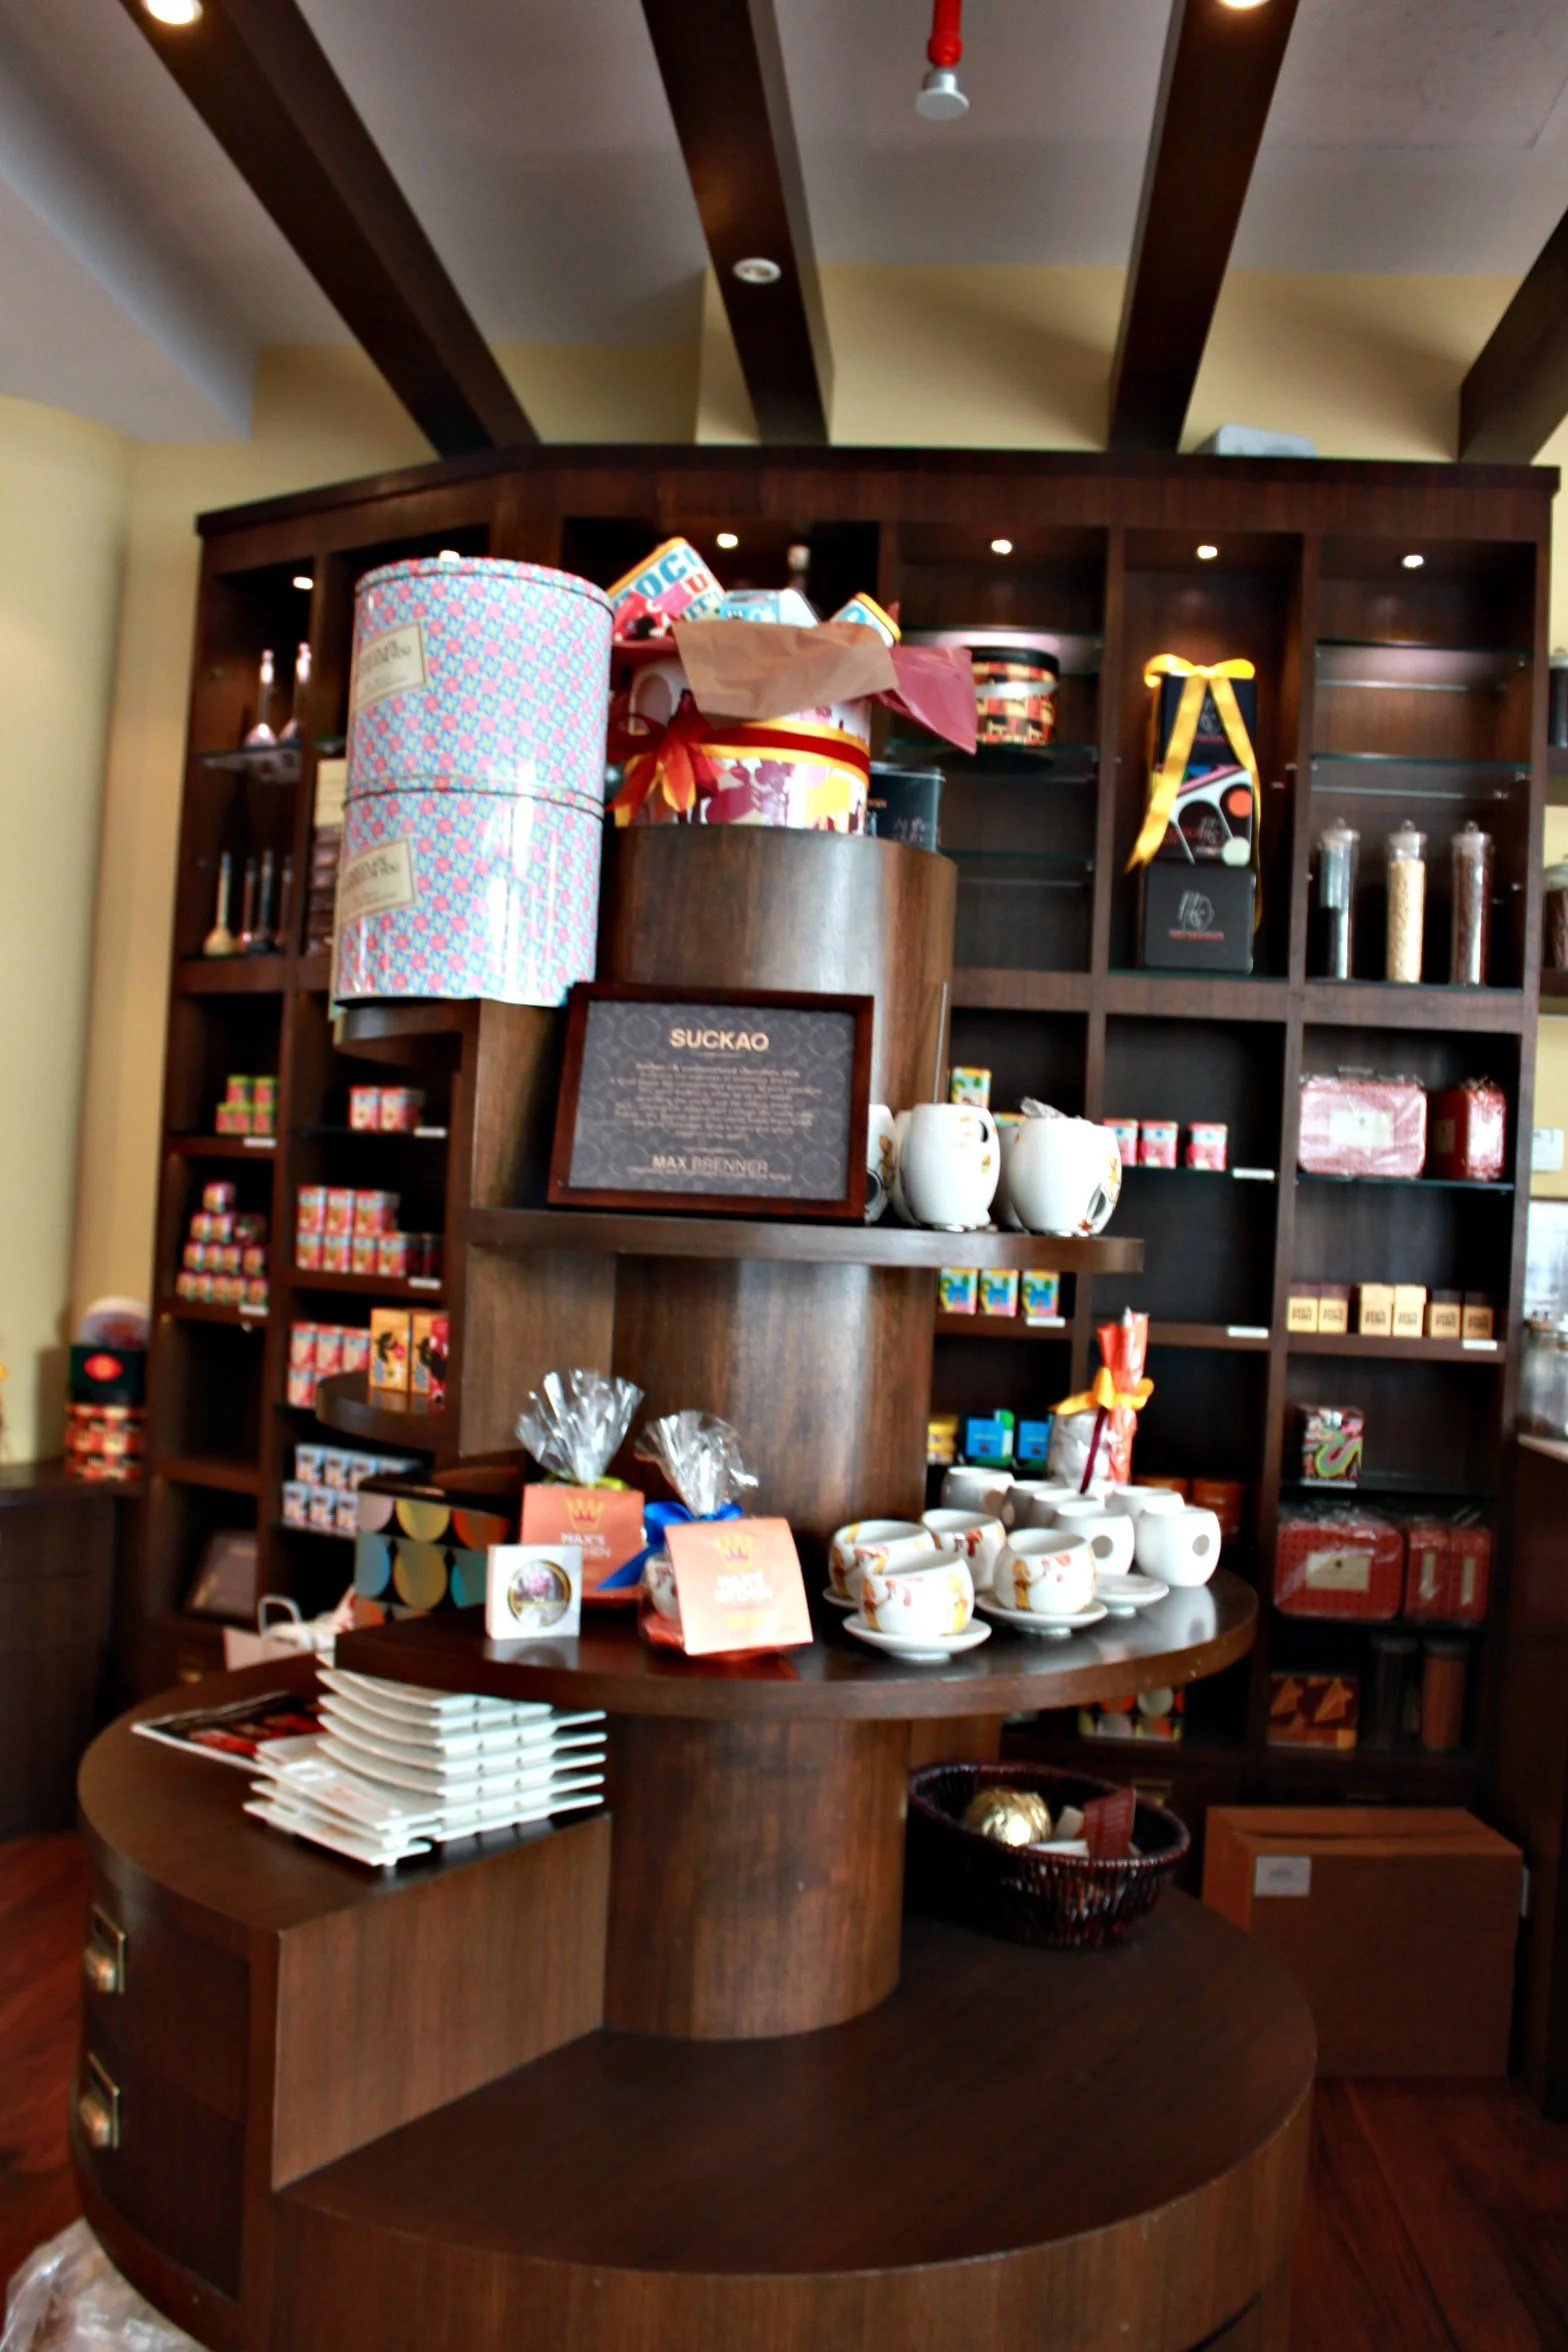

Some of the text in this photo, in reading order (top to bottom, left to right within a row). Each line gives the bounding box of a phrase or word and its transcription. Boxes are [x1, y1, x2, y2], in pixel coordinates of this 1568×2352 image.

[669, 1028, 769, 1051] SUCKAO
[651, 1154, 686, 1170] MAX
[692, 1156, 768, 1179] BRENNER
